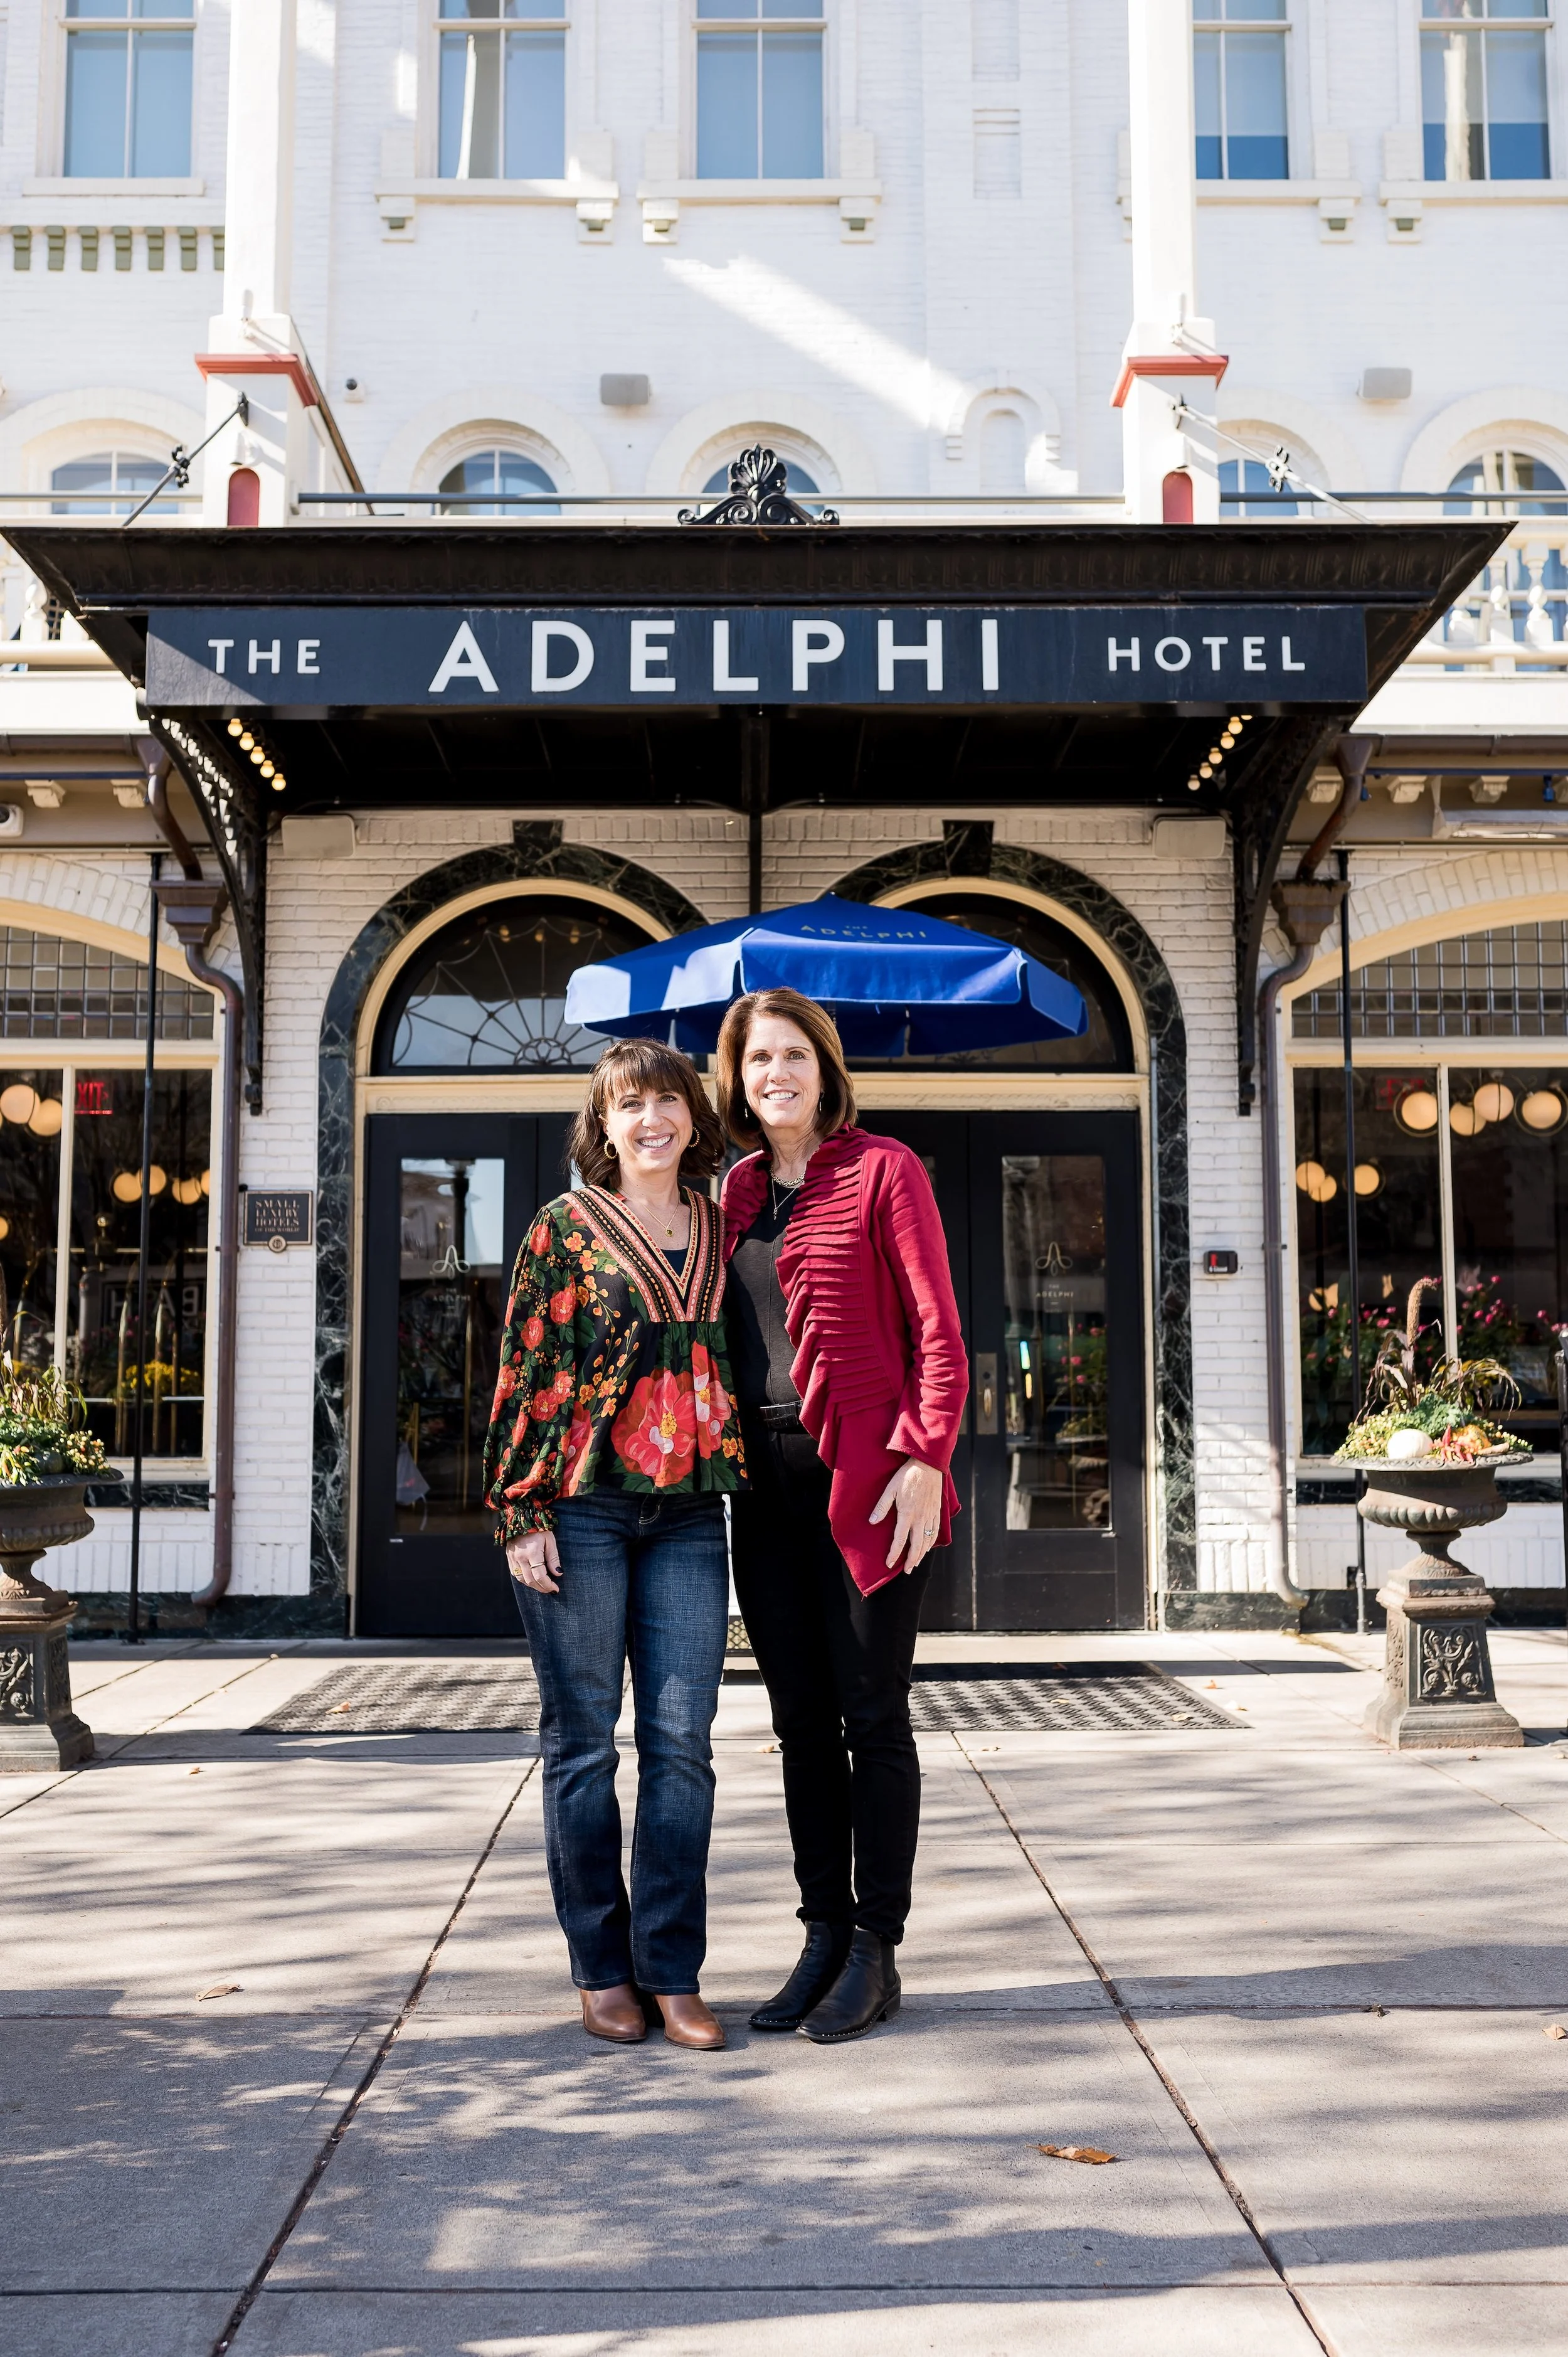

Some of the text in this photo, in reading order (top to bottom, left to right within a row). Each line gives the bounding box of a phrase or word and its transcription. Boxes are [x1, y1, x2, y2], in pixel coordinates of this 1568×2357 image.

[208, 619, 1306, 692] THE ADELPHI HOTEL
[800, 925, 927, 939] ADELPHI
[77, 1082, 105, 1110] XIT
[255, 1199, 300, 1208] SMALL
[255, 1208, 298, 1218] LUXURY
[255, 1218, 300, 1227] HOTELS
